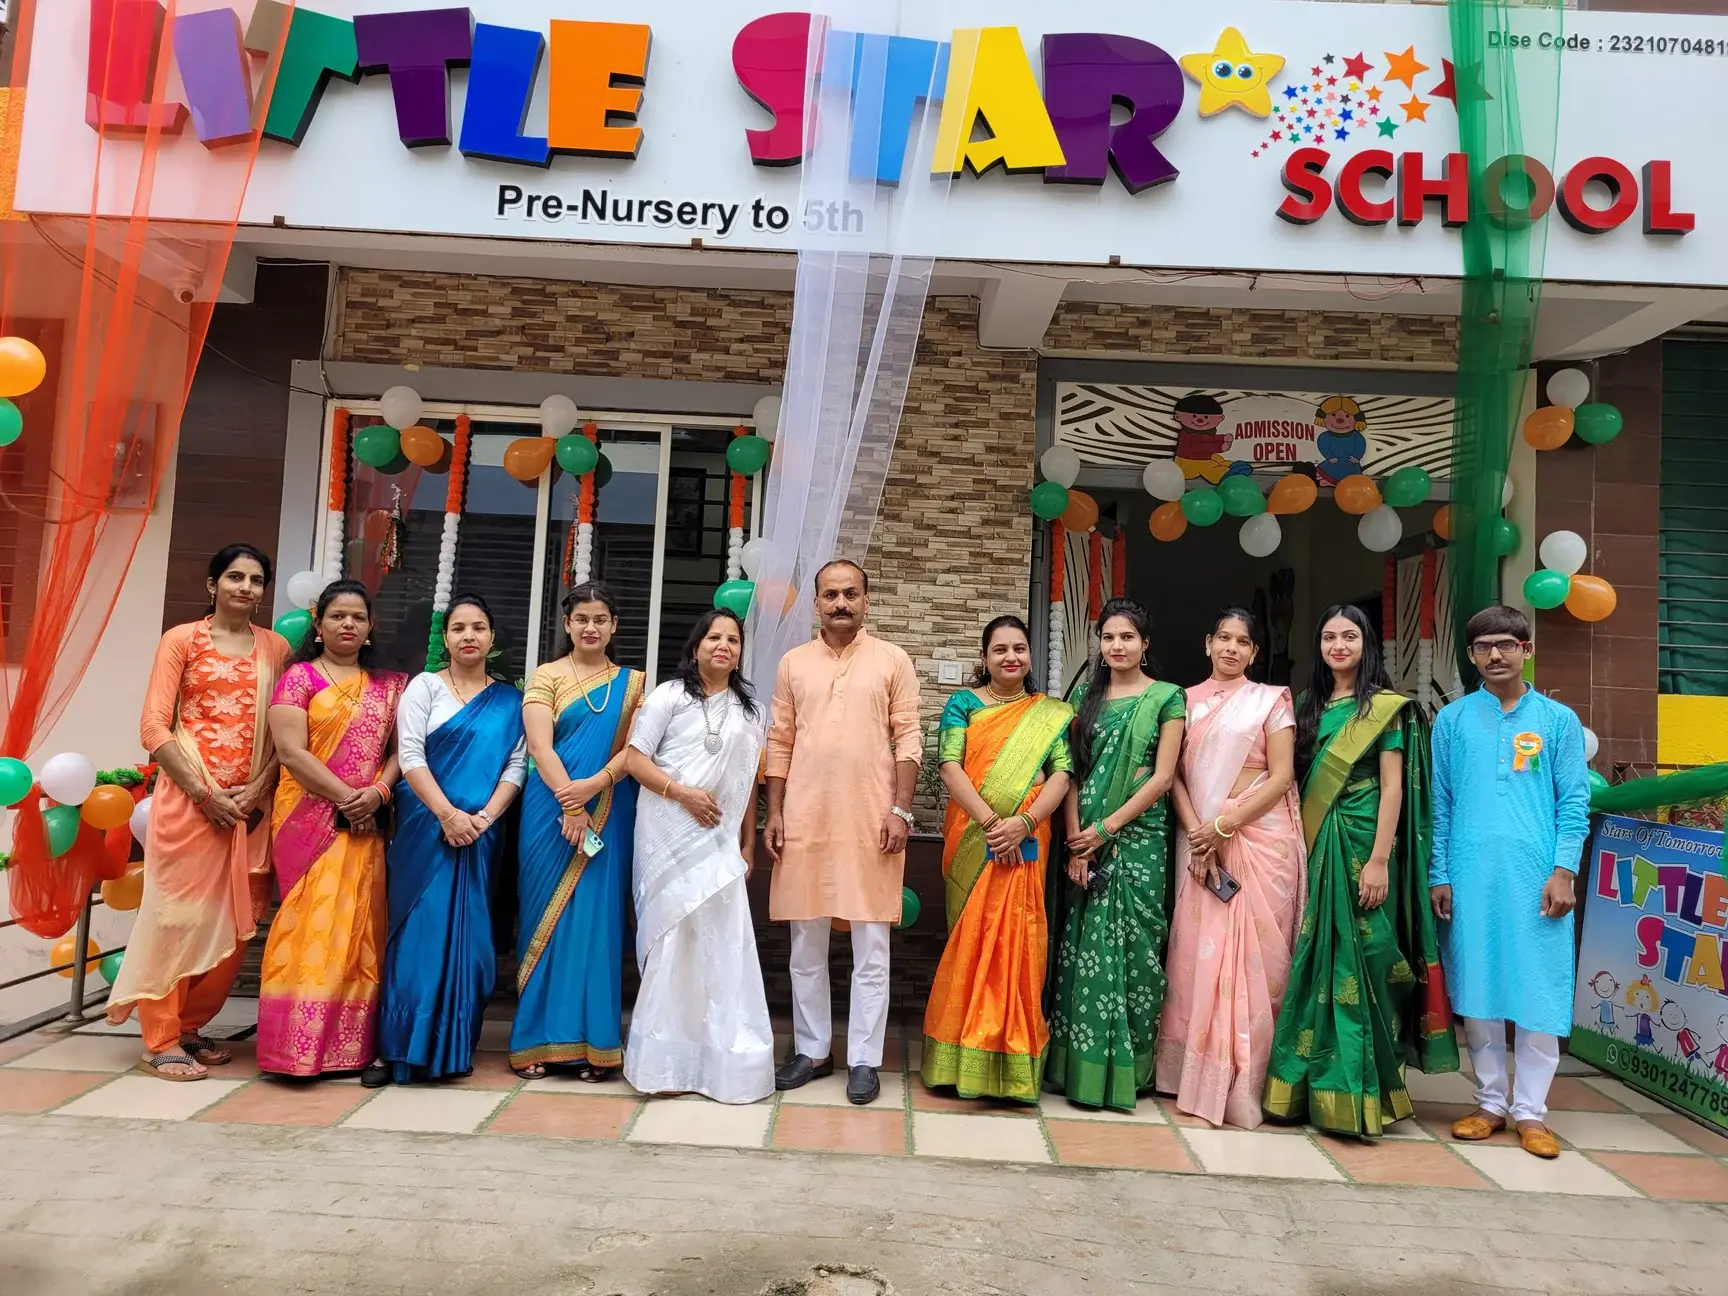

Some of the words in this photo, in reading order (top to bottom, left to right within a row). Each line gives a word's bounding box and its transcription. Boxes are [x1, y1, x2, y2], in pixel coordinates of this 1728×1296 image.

[1487, 30, 1532, 49] Dise
[1538, 32, 1591, 50] Code
[1607, 35, 1728, 55] 2321070481
[85, 0, 653, 169] LITTLE
[731, 11, 1185, 195] STAR
[498, 184, 739, 236] Pre-Nursery
[751, 197, 790, 230] to
[802, 199, 866, 233] 5th
[1275, 147, 1696, 237] SCHOOL
[1234, 420, 1316, 442] ADMISSION
[1252, 442, 1297, 462] OPEN
[1601, 820, 1633, 841] Stars
[1636, 827, 1657, 850] Of
[1597, 849, 1728, 929] LITTLE
[1635, 914, 1728, 999] STA
